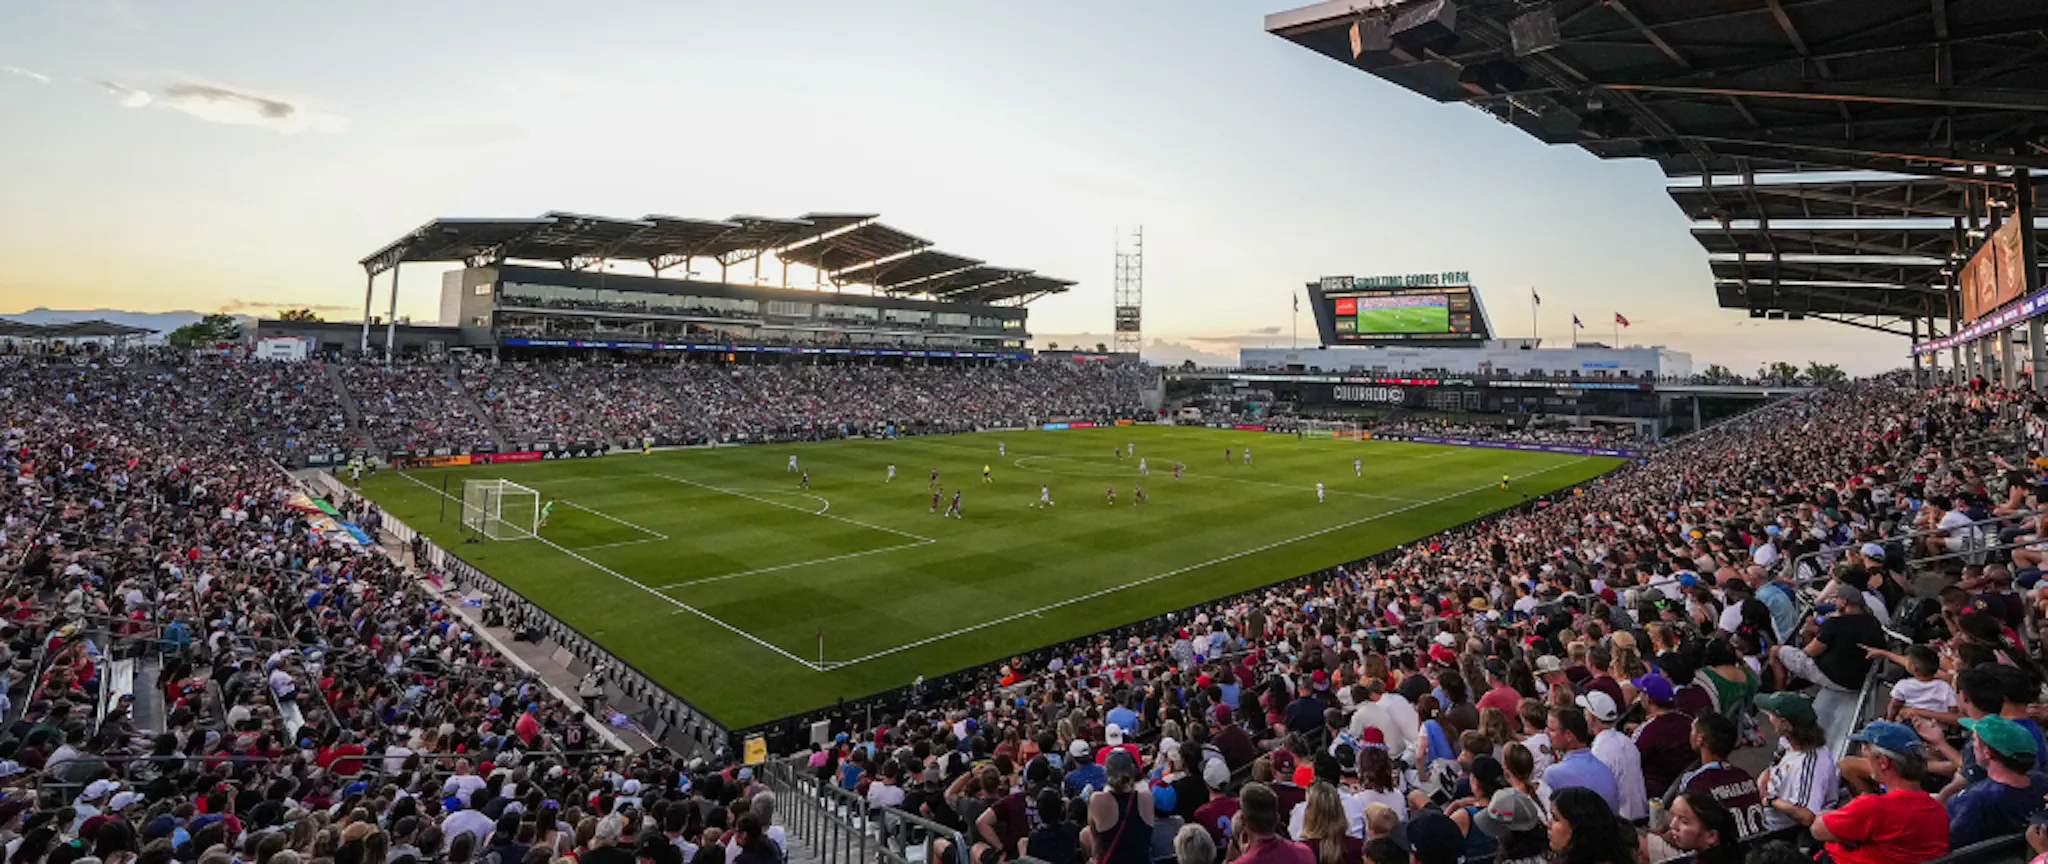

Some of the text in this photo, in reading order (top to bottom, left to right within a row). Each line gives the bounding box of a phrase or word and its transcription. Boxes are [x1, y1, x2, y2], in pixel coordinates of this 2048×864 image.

[1406, 274, 1438, 286] GOODS
[1442, 271, 1470, 284] PARK
[1333, 385, 1387, 401] COLORADO
[567, 729, 581, 745] 10
[1729, 803, 1763, 838] 10
